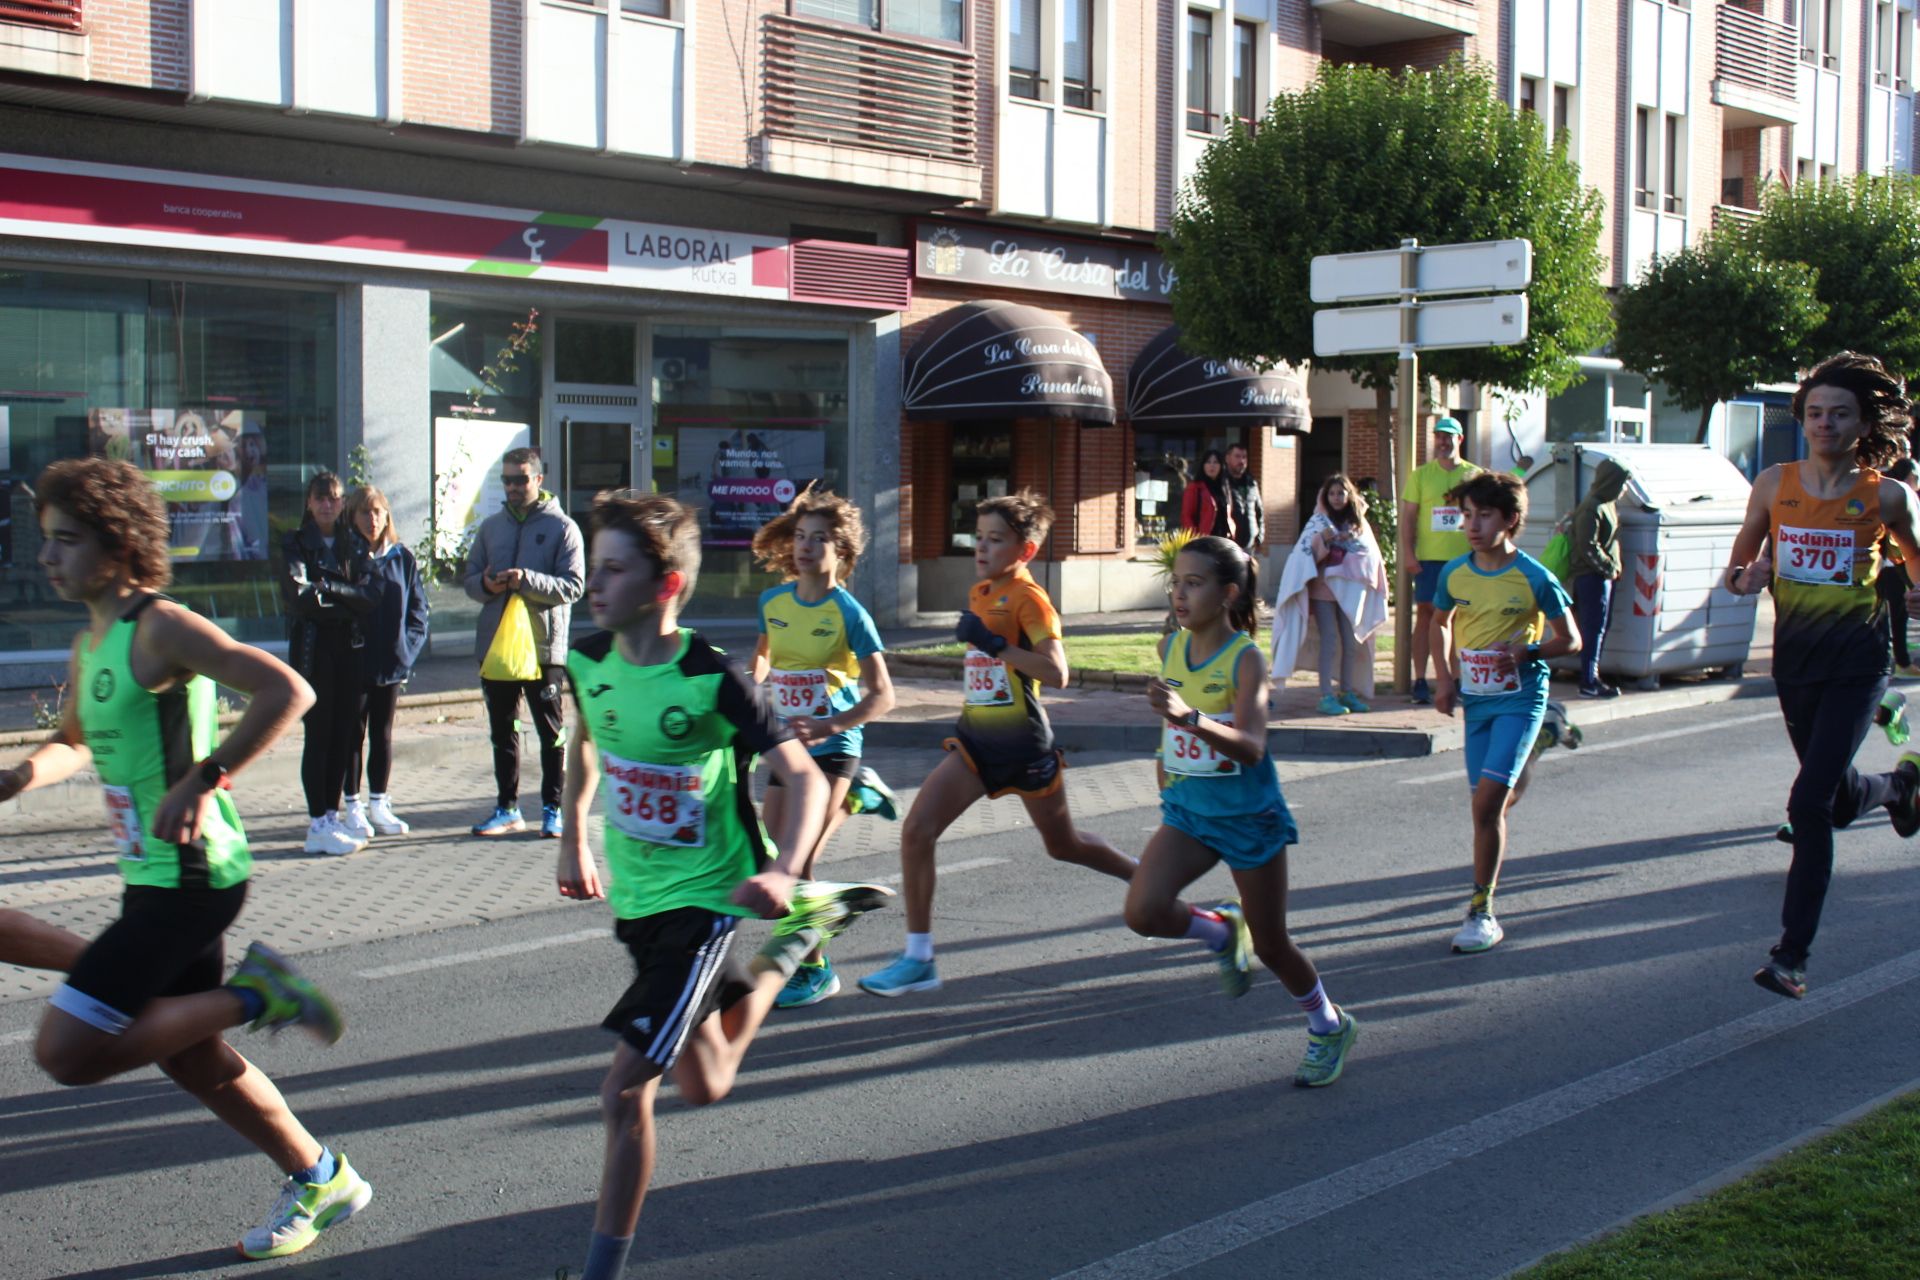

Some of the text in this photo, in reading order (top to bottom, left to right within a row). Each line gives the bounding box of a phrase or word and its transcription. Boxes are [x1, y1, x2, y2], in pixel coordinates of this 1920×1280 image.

[163, 203, 243, 219] banca cooperativa
[625, 232, 736, 265] LABORAL
[691, 264, 737, 285] kutxa
[988, 240, 1030, 278] La
[1039, 247, 1107, 286] Casa
[1115, 258, 1150, 291] del
[984, 343, 1012, 365] La
[1015, 338, 1059, 355] Casa
[1203, 360, 1229, 379] La
[160, 435, 180, 448] hay
[182, 434, 214, 447] crush,
[155, 447, 206, 460] hay cash.
[761, 450, 778, 458] nos
[720, 460, 749, 468] vamos
[752, 459, 762, 468] de
[712, 485, 728, 495] ME
[729, 485, 771, 496] PIROOO
[1442, 515, 1455, 525] 56
[1780, 529, 1852, 548] bedunia
[1791, 547, 1836, 570] 370
[779, 688, 814, 707] 369
[603, 755, 702, 792] bedunia
[617, 786, 678, 824] 368
